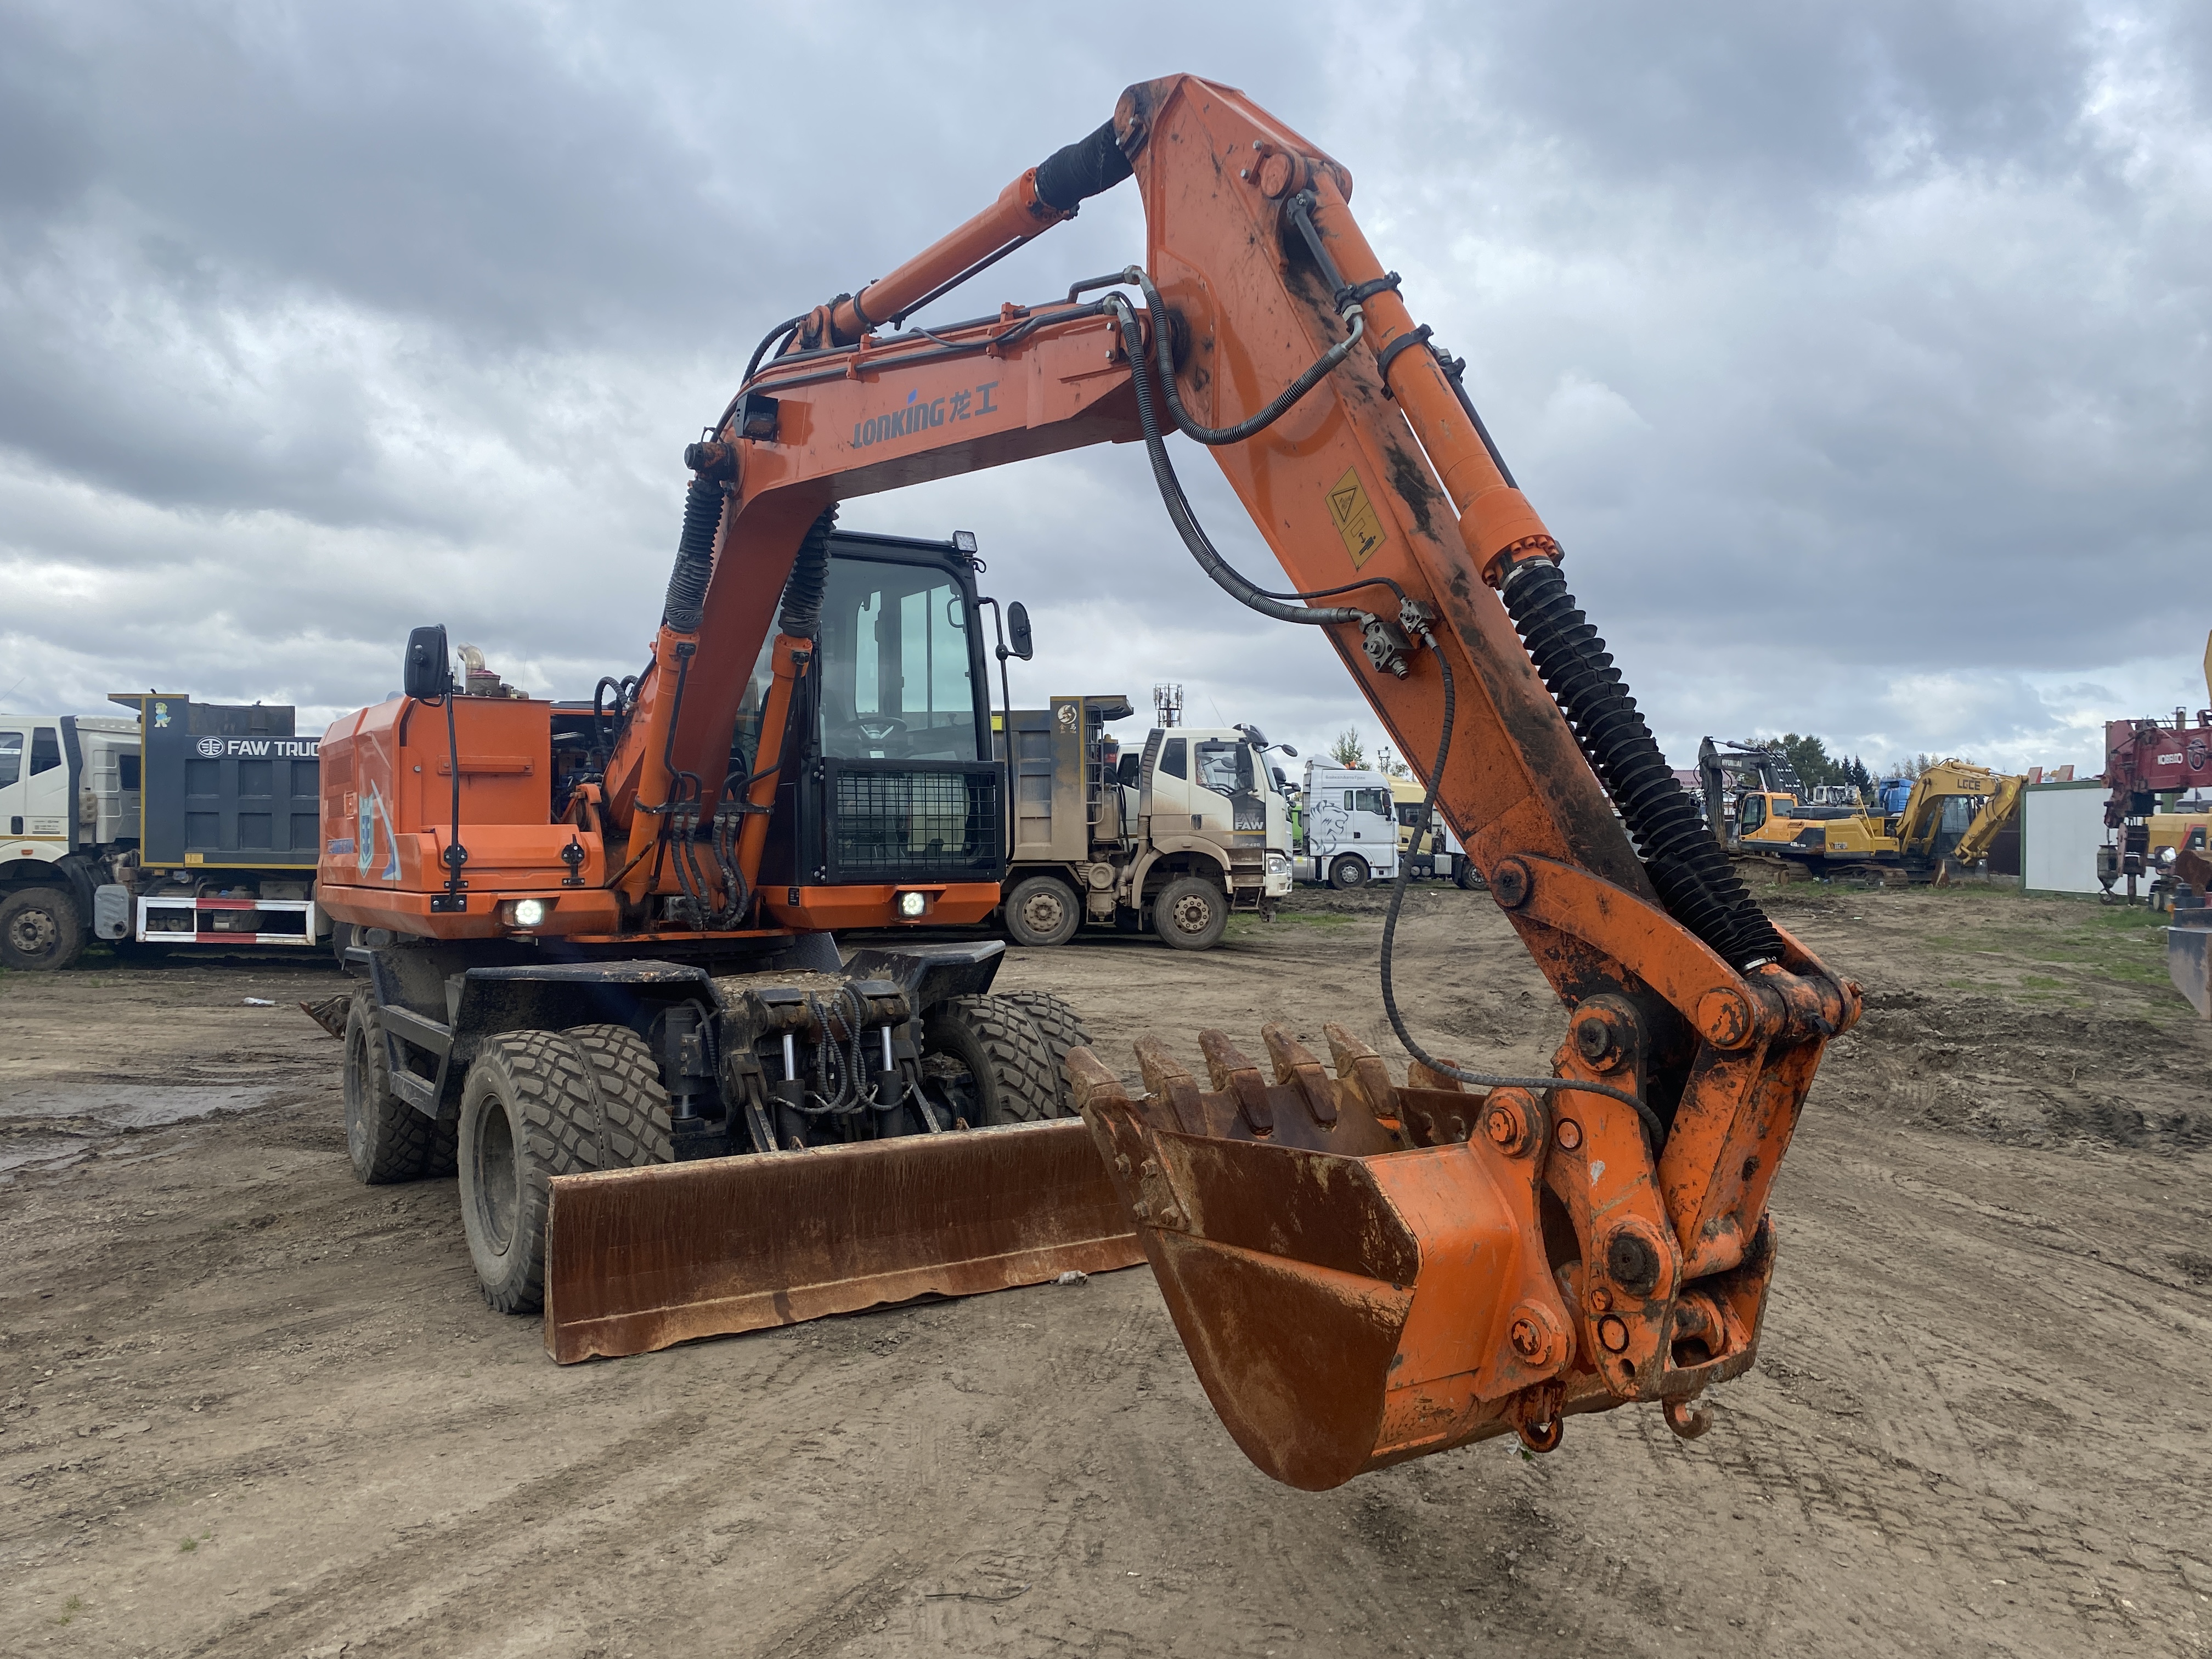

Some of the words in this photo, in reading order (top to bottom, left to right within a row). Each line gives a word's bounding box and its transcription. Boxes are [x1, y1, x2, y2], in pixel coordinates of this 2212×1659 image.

[949, 380, 998, 423] 龙工
[227, 740, 270, 755] FAW
[1722, 759, 1742, 768] HYUNDAI
[1957, 778, 1980, 791] LGCE
[1235, 821, 1263, 830] FAW
